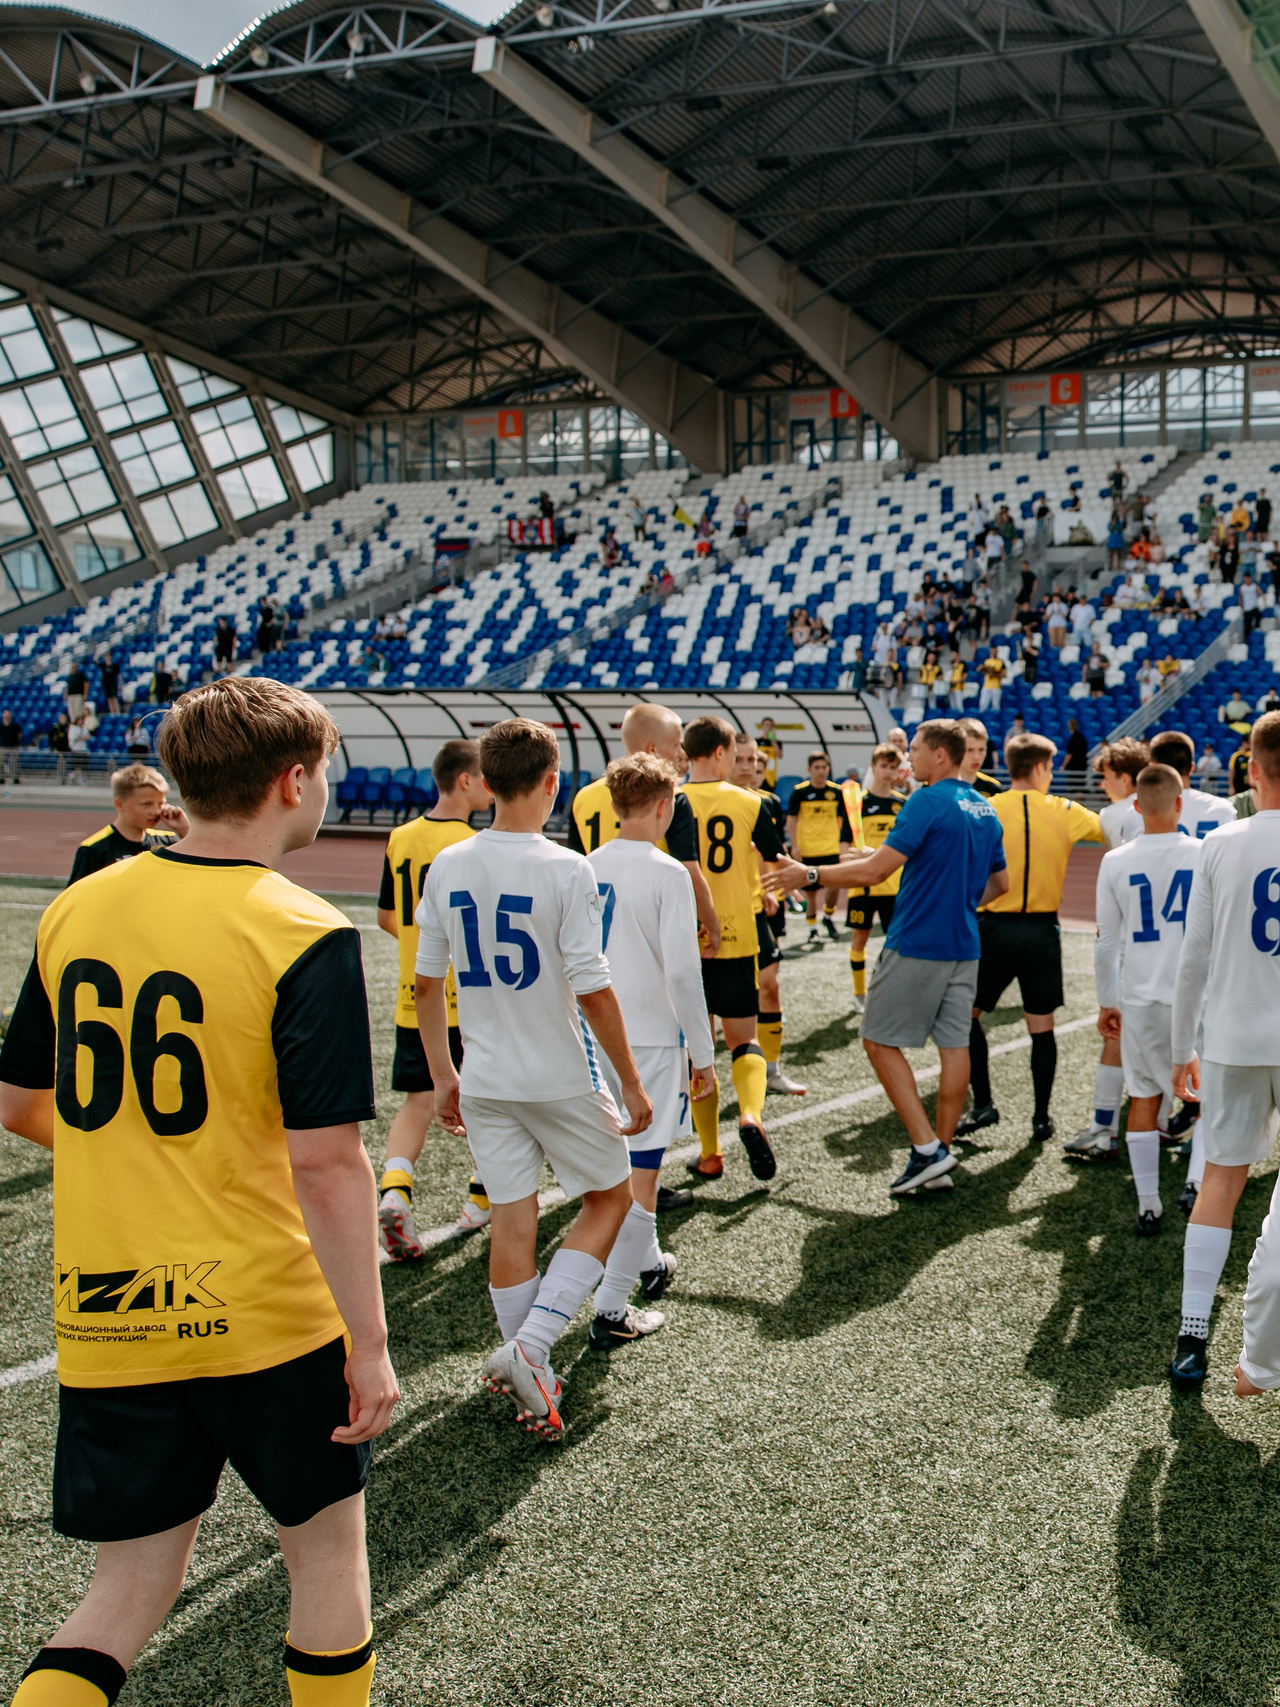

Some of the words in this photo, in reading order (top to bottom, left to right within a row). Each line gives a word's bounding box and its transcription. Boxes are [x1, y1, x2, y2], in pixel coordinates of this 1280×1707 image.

[585, 811, 621, 853] 1
[1129, 869, 1194, 943] 14
[449, 890, 540, 990] 15
[55, 957, 208, 1137] 66
[56, 1320, 130, 1334] ИННОВАЦИОННЫЙ
[132, 1324, 167, 1333] ЗАВОД
[77, 1332, 148, 1343] КОНСТРУКЦИЙ
[177, 1318, 230, 1339] RUS
